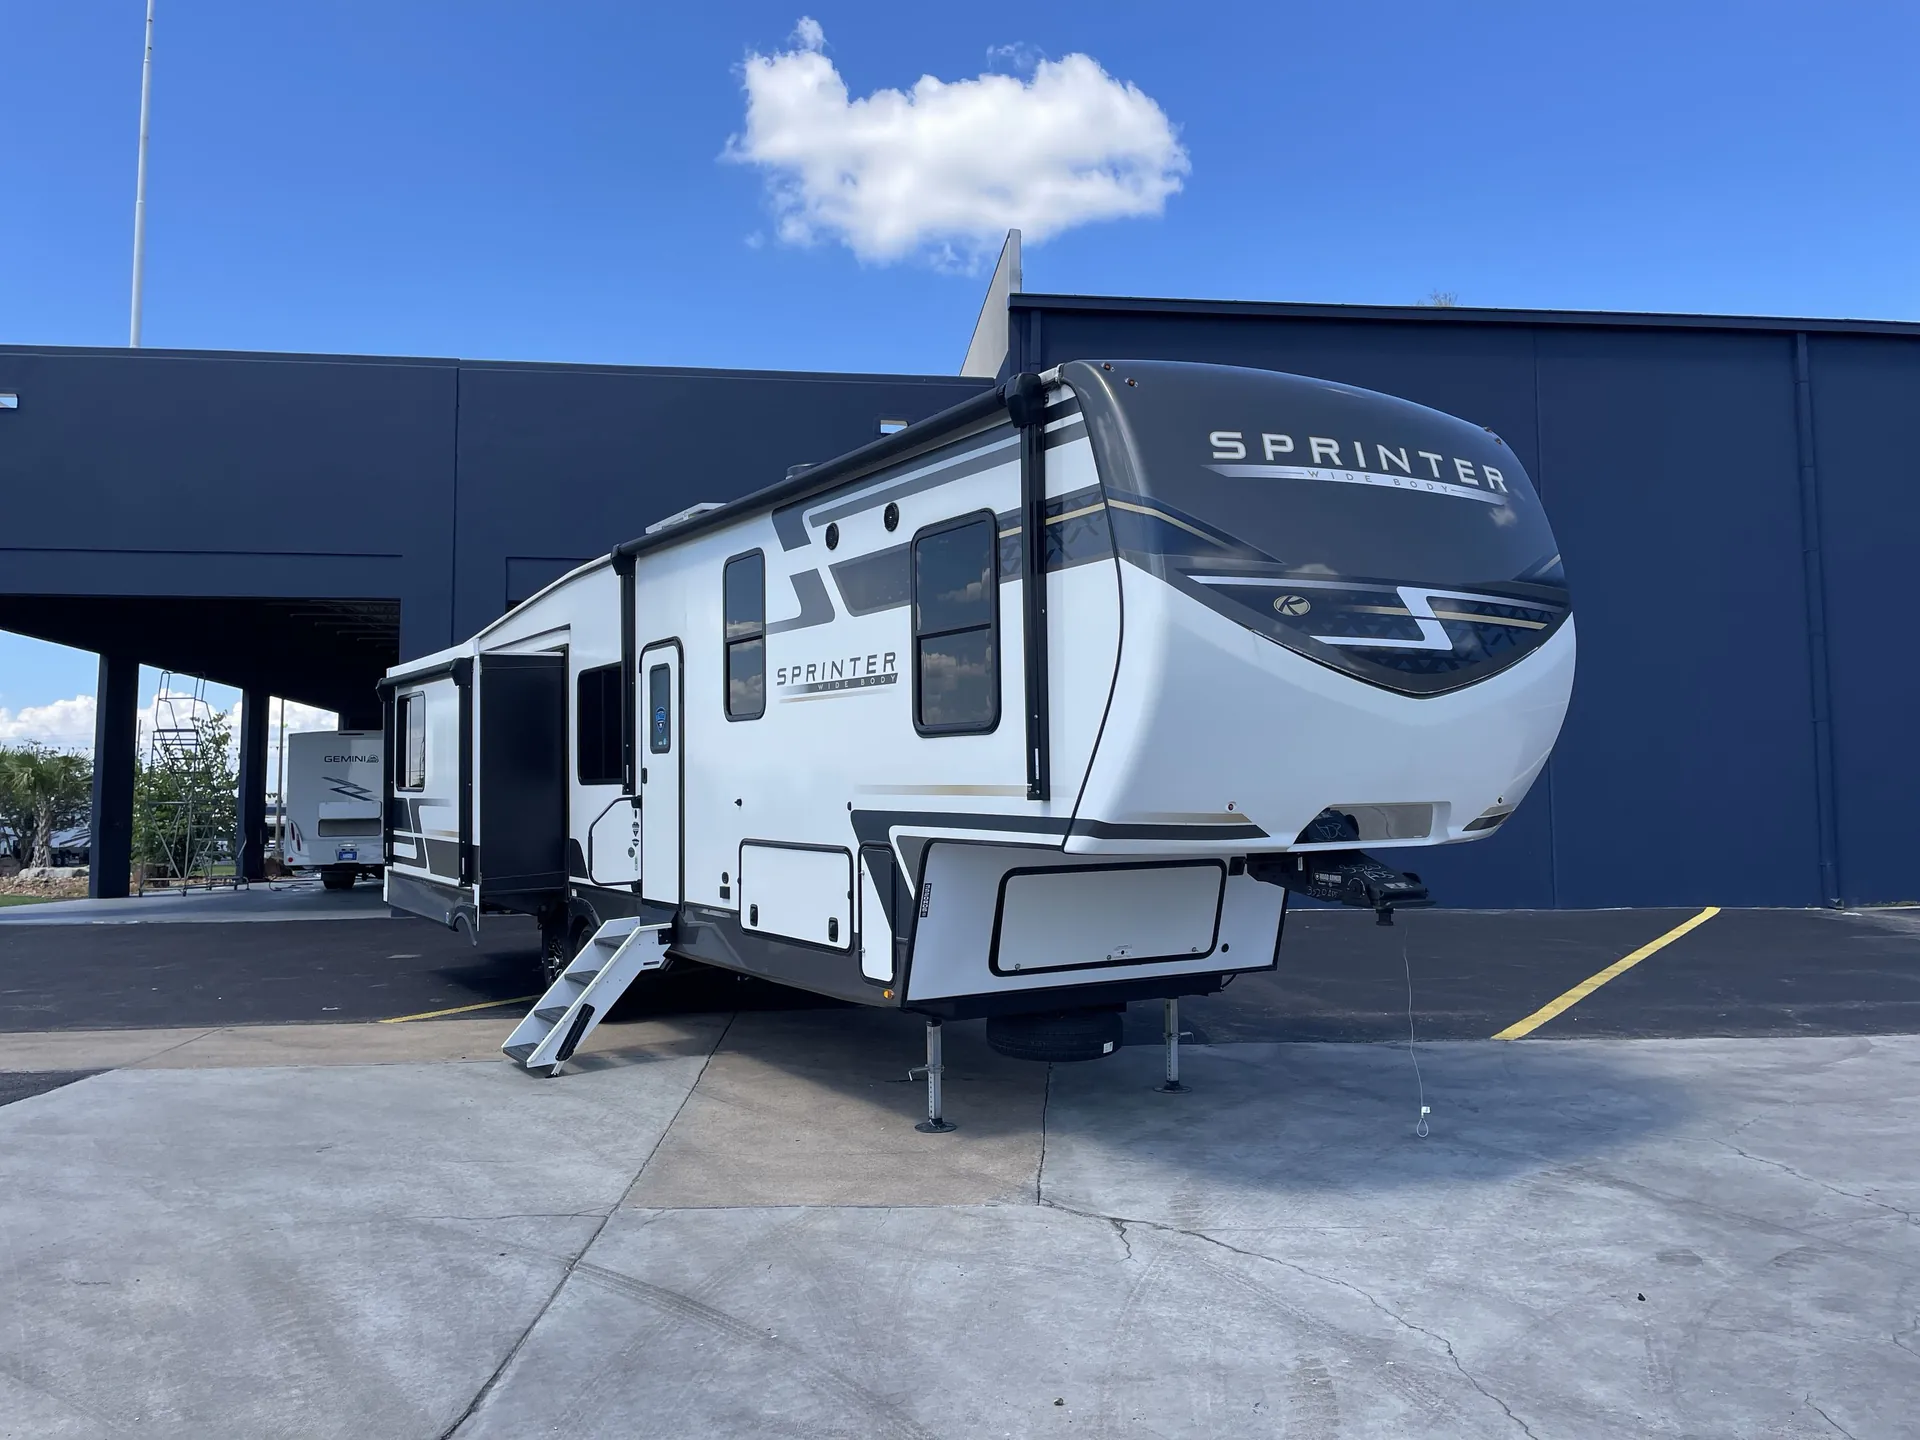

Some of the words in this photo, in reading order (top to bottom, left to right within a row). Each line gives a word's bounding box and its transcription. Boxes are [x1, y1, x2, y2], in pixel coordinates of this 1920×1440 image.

[1209, 431, 1509, 493] SPRINTER
[1307, 470, 1373, 483] WIDE
[1392, 478, 1448, 493] BODY
[776, 651, 896, 686] SPRINTER
[817, 680, 849, 691] WIDE
[860, 674, 897, 686] BODY
[323, 755, 366, 763] GEMINI
